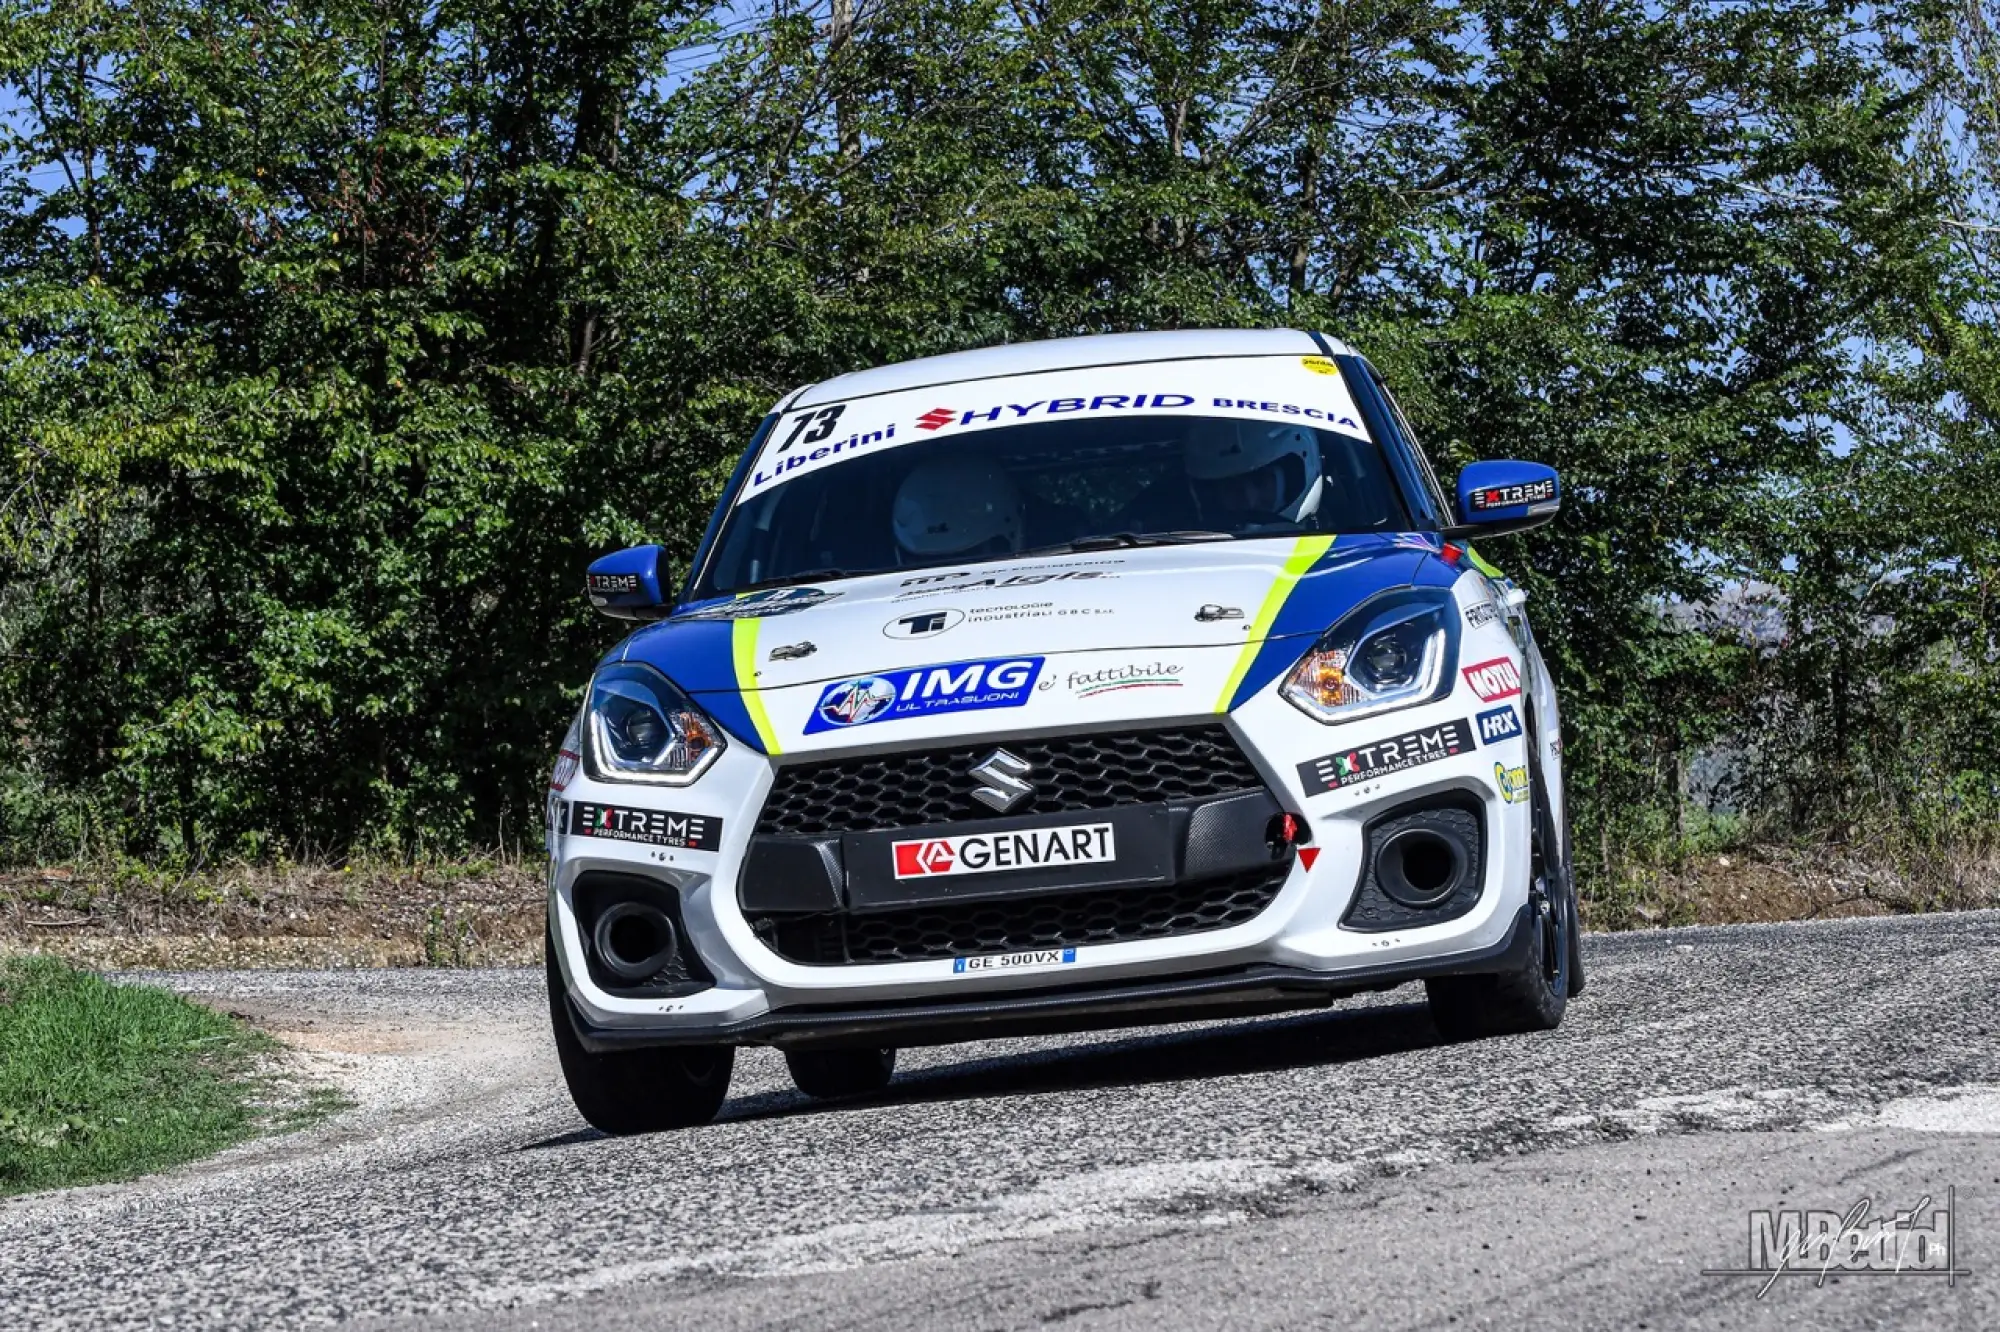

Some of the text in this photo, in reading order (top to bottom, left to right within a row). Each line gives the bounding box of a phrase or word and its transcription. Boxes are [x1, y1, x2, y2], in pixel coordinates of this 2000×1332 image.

[959, 394, 1196, 426] HYBRID
[1213, 397, 1360, 430] BRESCIA
[777, 404, 847, 454] 73
[753, 423, 896, 487] Liberini
[1474, 480, 1554, 505] EXTREME
[900, 661, 1033, 701] IMG
[1067, 661, 1184, 689] fattibile
[895, 691, 1020, 712] ULTRASUONI
[1482, 711, 1518, 739] HRX
[1316, 725, 1460, 782] EXTREME
[1340, 749, 1447, 786] PERFORMANCE TYRES
[582, 805, 705, 839] EXTREME
[593, 828, 687, 847] PERFORMANCE TYRES
[959, 827, 1109, 869] GENART
[968, 950, 1060, 969] GE 500VX
